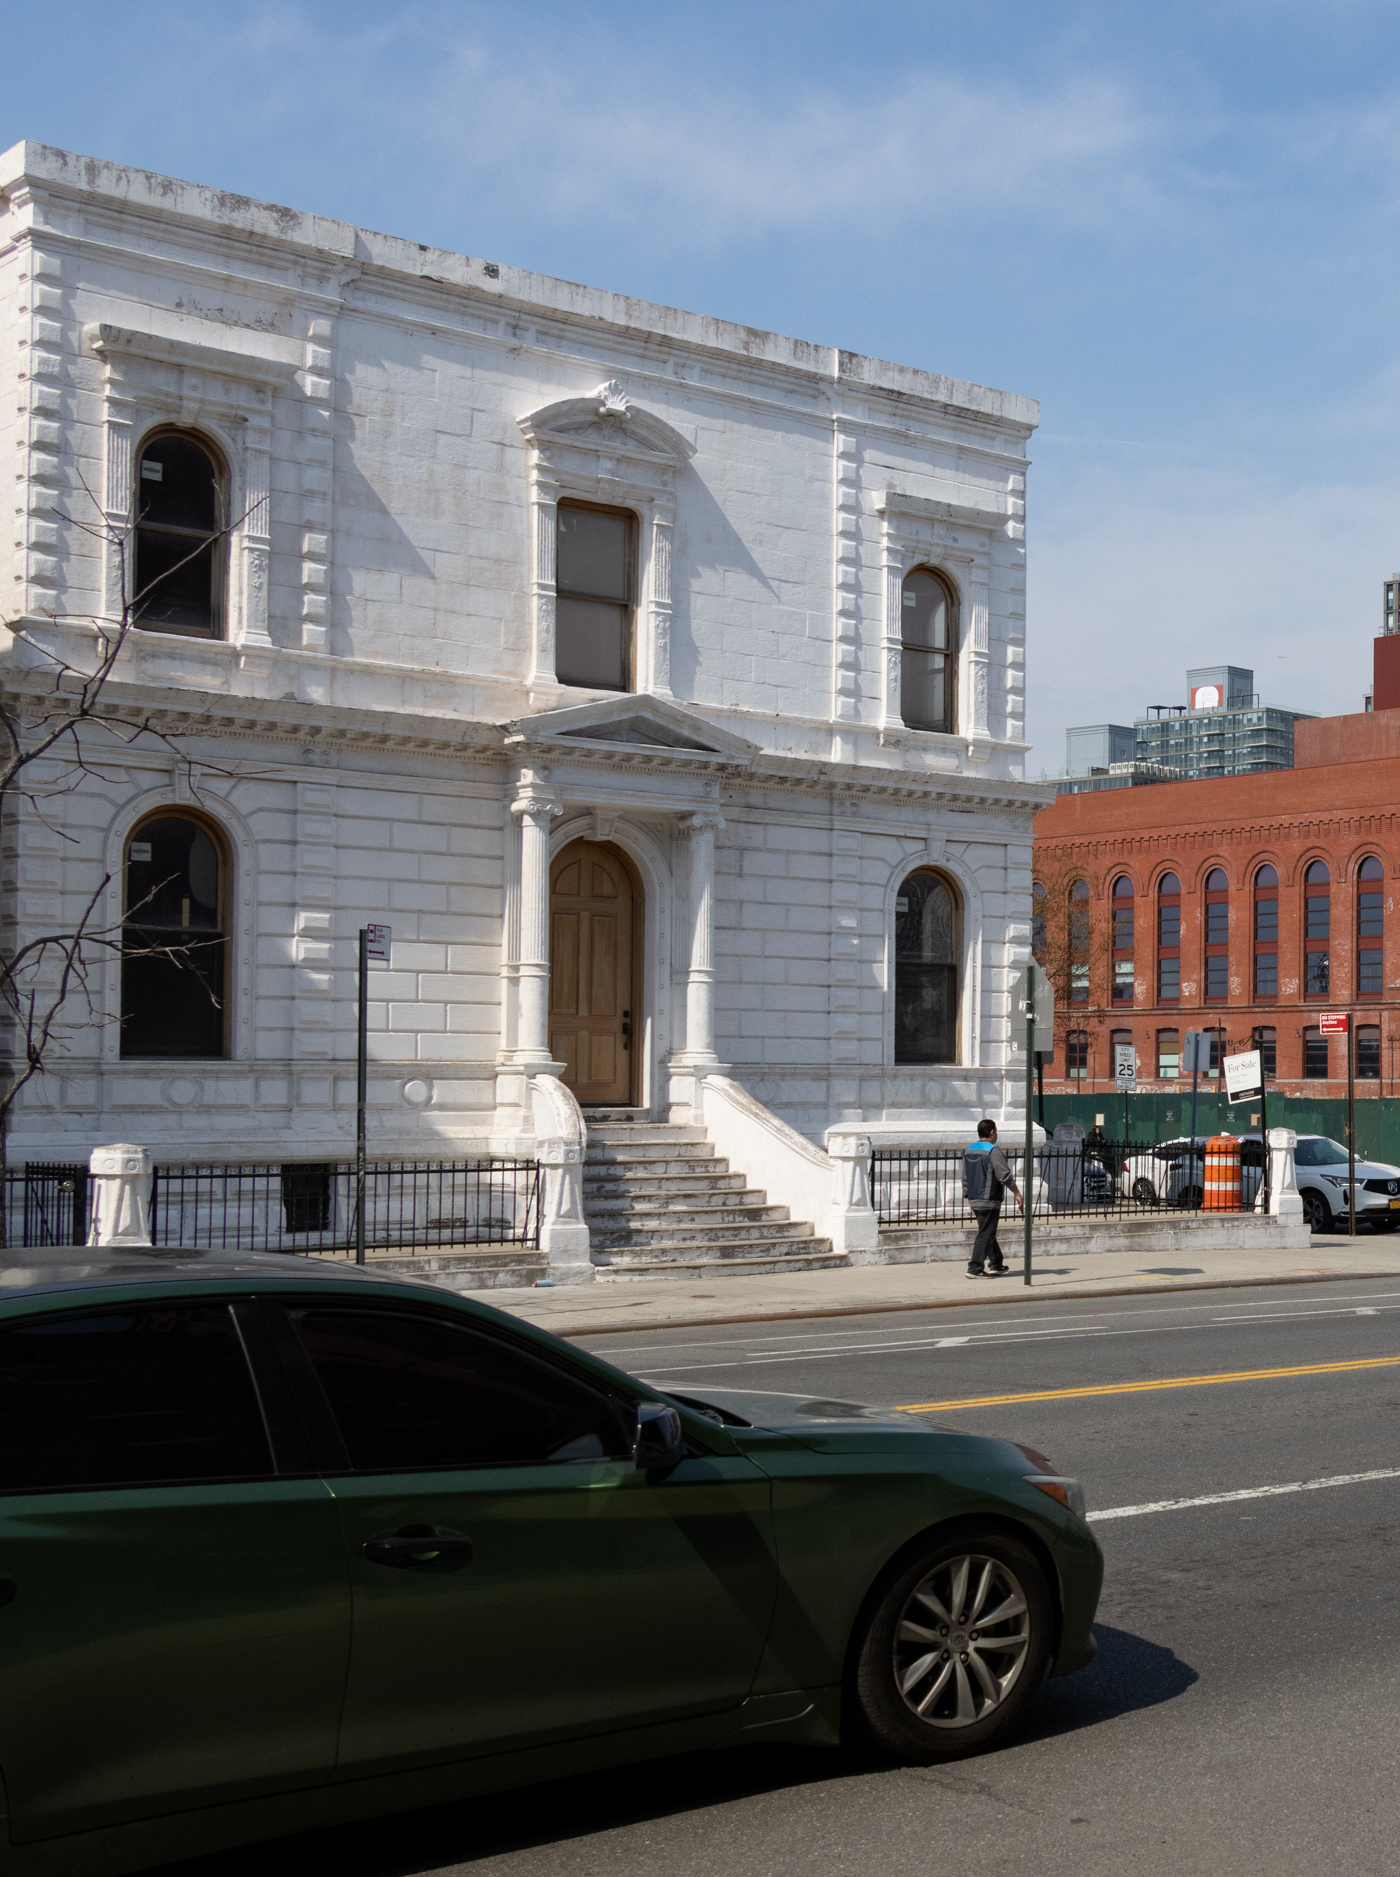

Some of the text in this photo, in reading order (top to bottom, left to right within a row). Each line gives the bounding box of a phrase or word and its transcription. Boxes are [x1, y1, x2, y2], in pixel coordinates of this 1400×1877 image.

[1118, 1063, 1134, 1077] 25
[1227, 1059, 1257, 1074] For Sale
